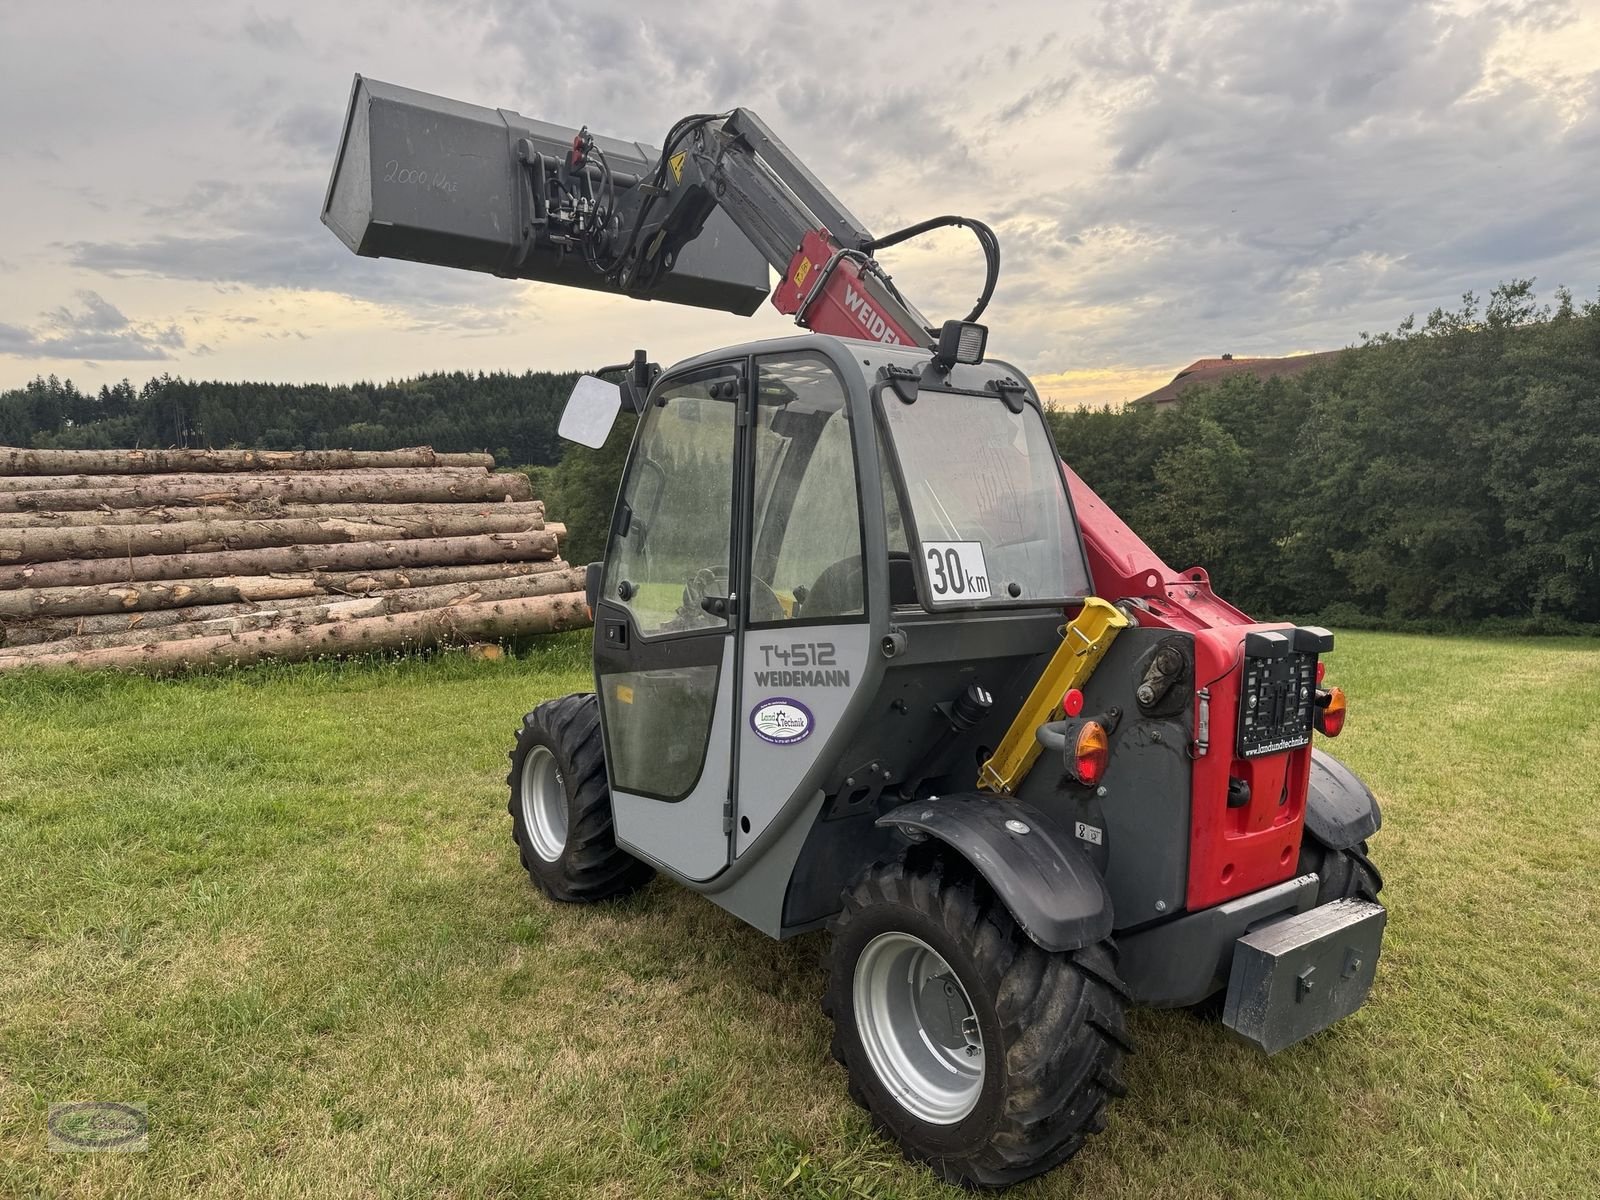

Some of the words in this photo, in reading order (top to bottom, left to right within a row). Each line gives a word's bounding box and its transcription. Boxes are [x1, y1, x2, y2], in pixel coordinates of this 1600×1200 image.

[927, 548, 965, 595] 30
[965, 569, 988, 593] km
[759, 642, 837, 667] T4512
[754, 670, 850, 687] WEIDEMANN
[760, 712, 776, 722] Land
[780, 717, 805, 728] Technik
